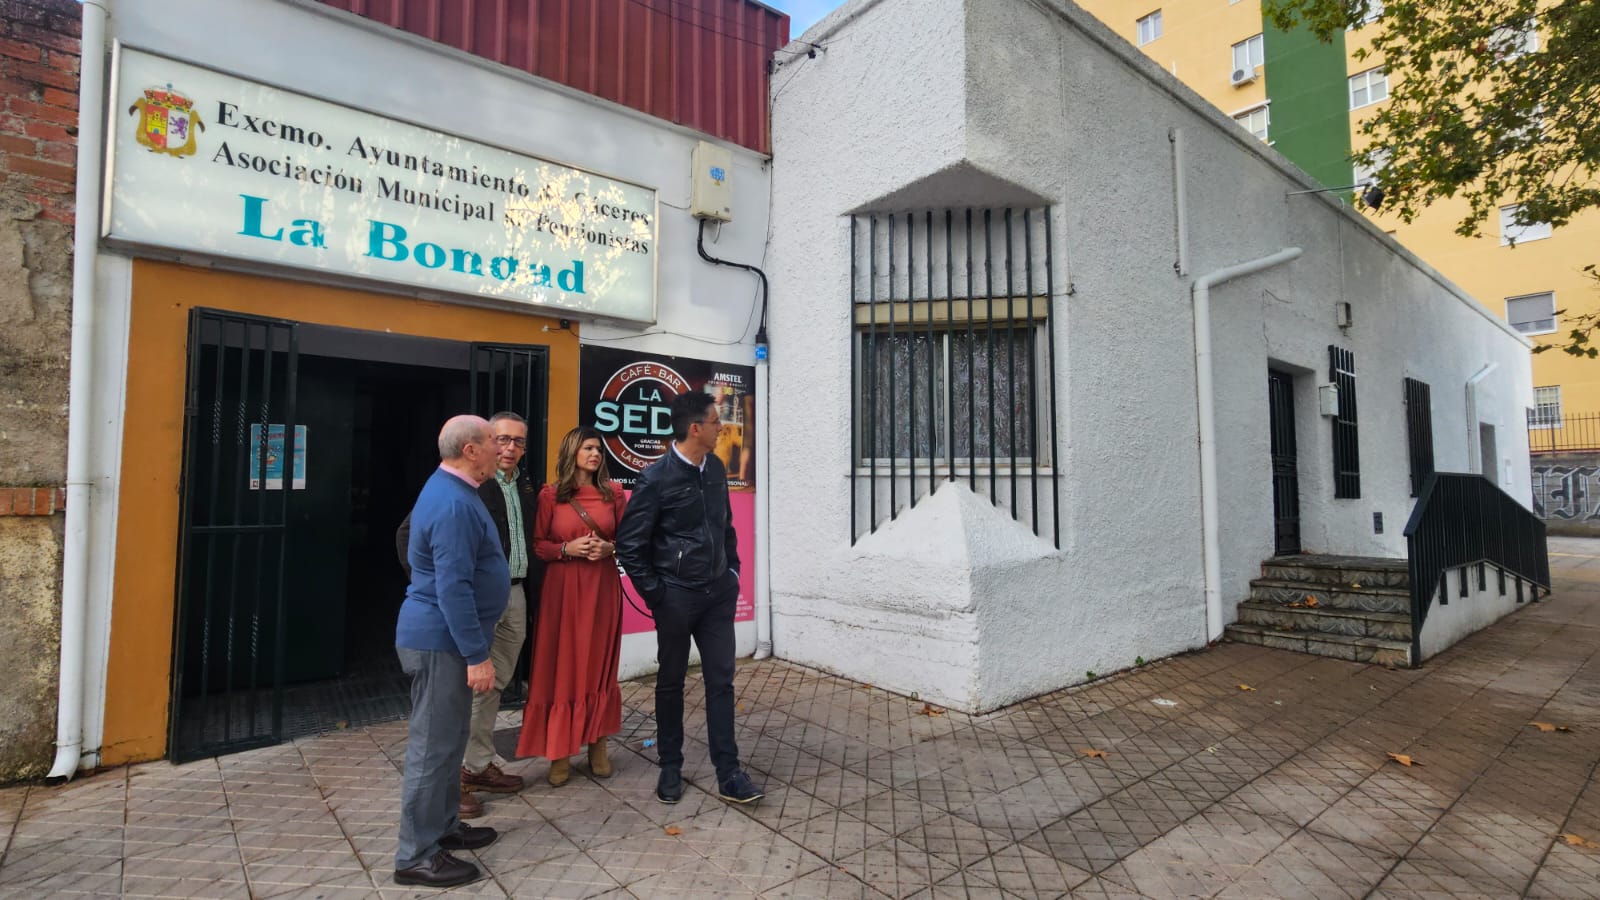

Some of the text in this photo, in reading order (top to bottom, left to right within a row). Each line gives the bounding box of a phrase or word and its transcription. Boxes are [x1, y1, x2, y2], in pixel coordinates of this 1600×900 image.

[216, 100, 333, 151] Excmo.
[347, 135, 530, 198] Ayuntamiento
[573, 191, 649, 226] Cceres
[212, 141, 363, 194] Asociación
[376, 176, 495, 223] Municipal
[237, 193, 329, 250] La
[620, 363, 652, 383] CAFÉ
[658, 368, 682, 389] BAR
[713, 372, 743, 383] AMSTEL
[639, 387, 662, 402] LA
[594, 401, 674, 436] SED
[620, 449, 632, 462] LA
